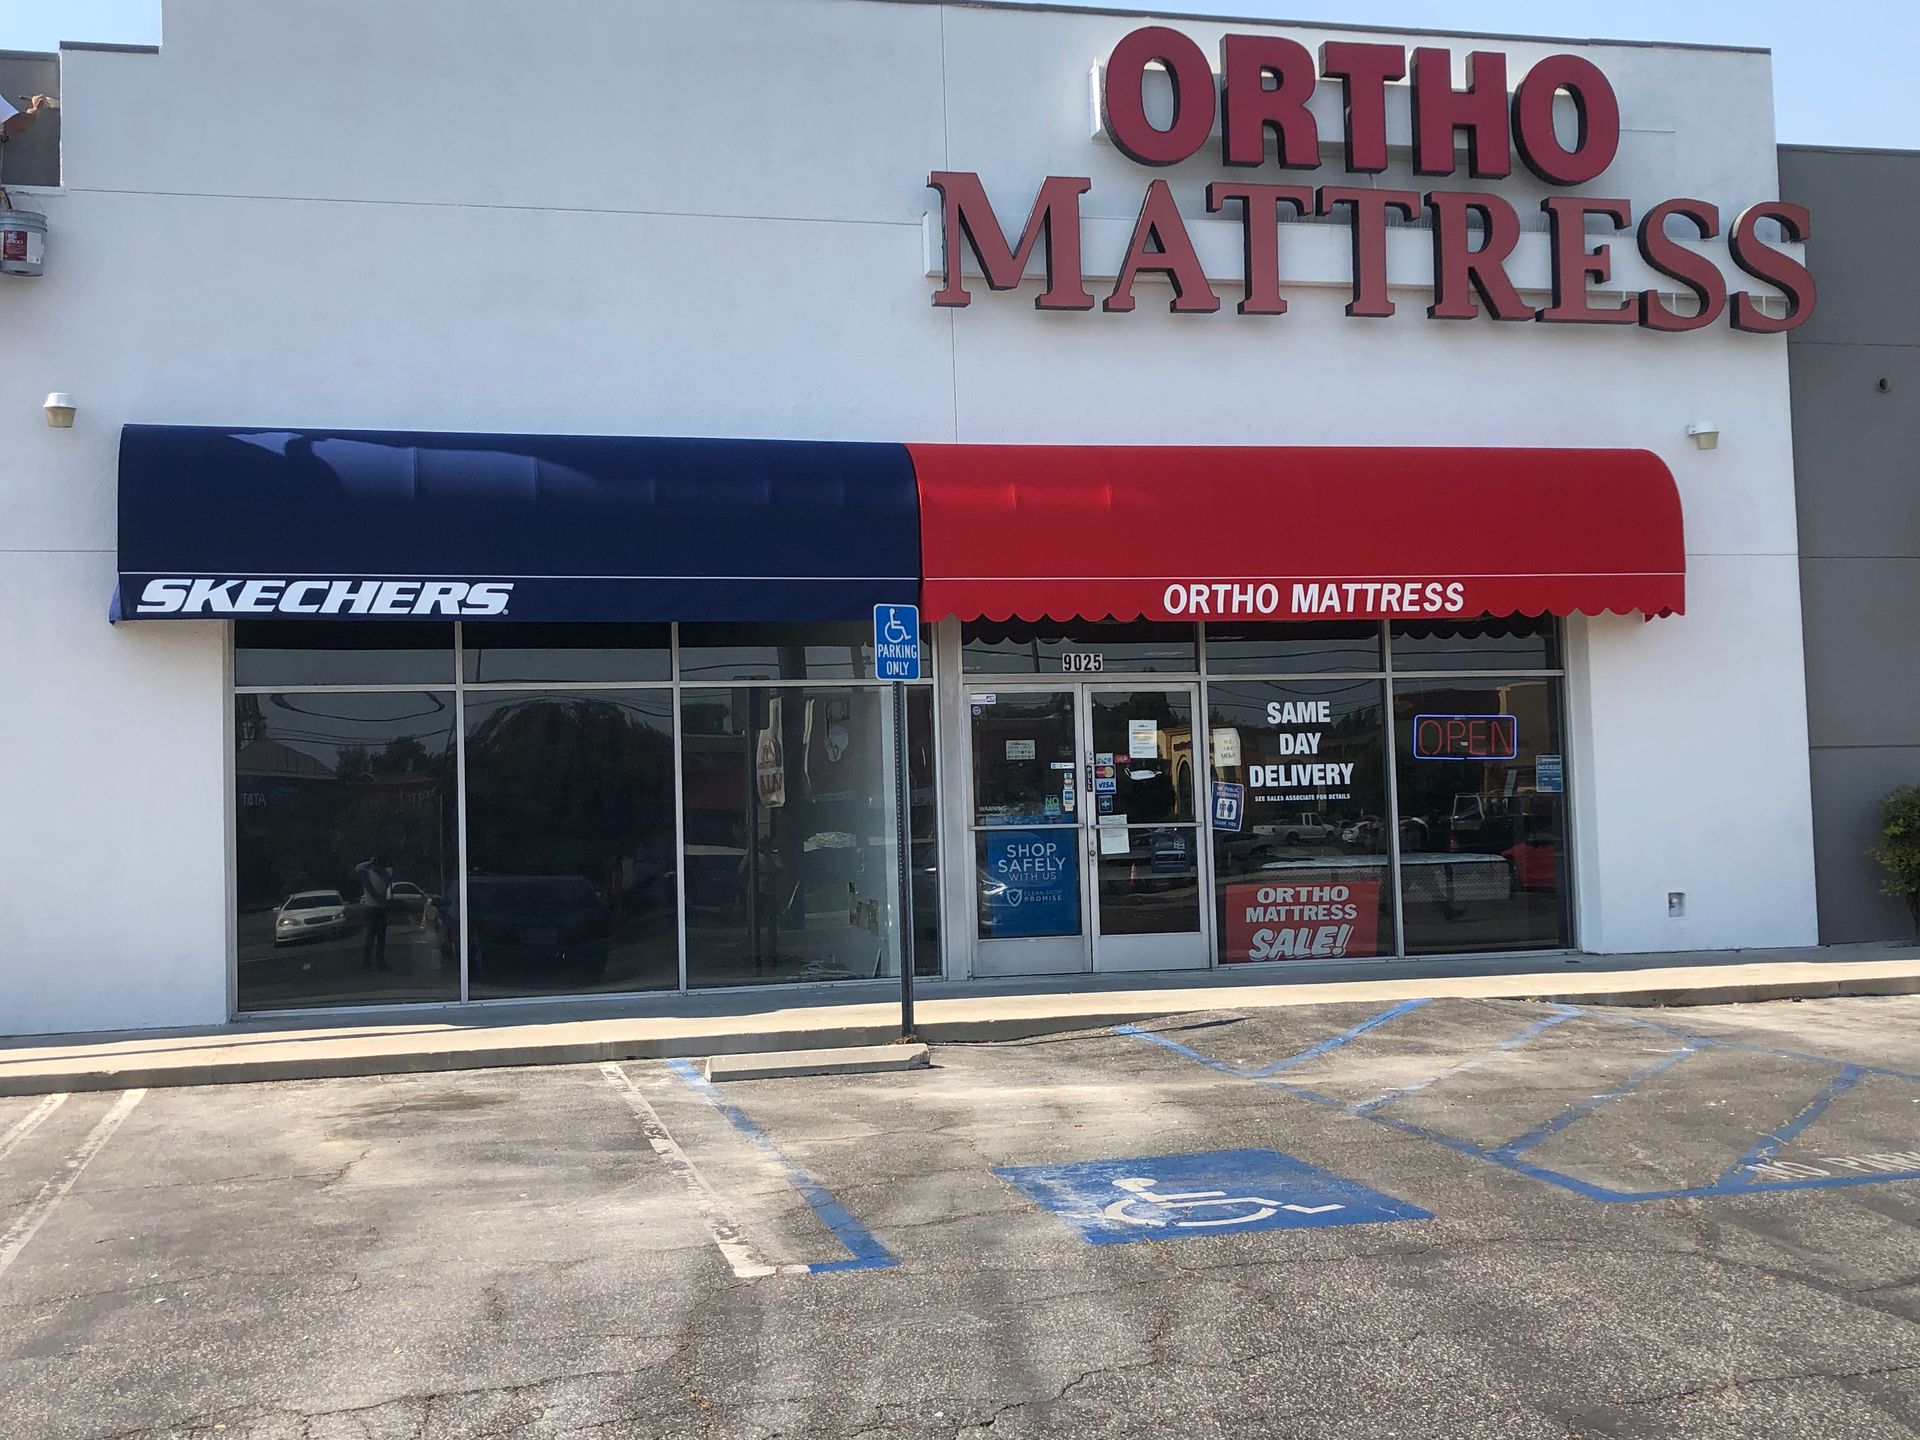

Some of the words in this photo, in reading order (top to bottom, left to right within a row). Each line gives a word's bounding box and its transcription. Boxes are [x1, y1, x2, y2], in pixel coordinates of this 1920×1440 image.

[1102, 26, 1620, 186] ORTHO
[927, 170, 1817, 334] MATTRESS
[136, 578, 514, 615] SKECHERS
[1163, 583, 1279, 614] ORTHO
[1291, 582, 1465, 614] MATTRESS
[877, 644, 917, 659] PARKING
[886, 661, 909, 676] ONLY
[1063, 654, 1102, 671] 9025
[1267, 701, 1331, 724] SAME
[1279, 732, 1321, 755] DAY
[1417, 719, 1514, 756] OPEN
[1098, 781, 1115, 789] VISA
[1249, 763, 1354, 787] DELIVERY
[1007, 842, 1056, 858] SHOP
[998, 857, 1066, 873] SAFELY
[1008, 873, 1038, 881] WITH
[1042, 872, 1056, 880] US
[1256, 885, 1349, 904] ORTHO
[1246, 904, 1358, 923] MATTRESS
[1249, 923, 1354, 962] SALE!
